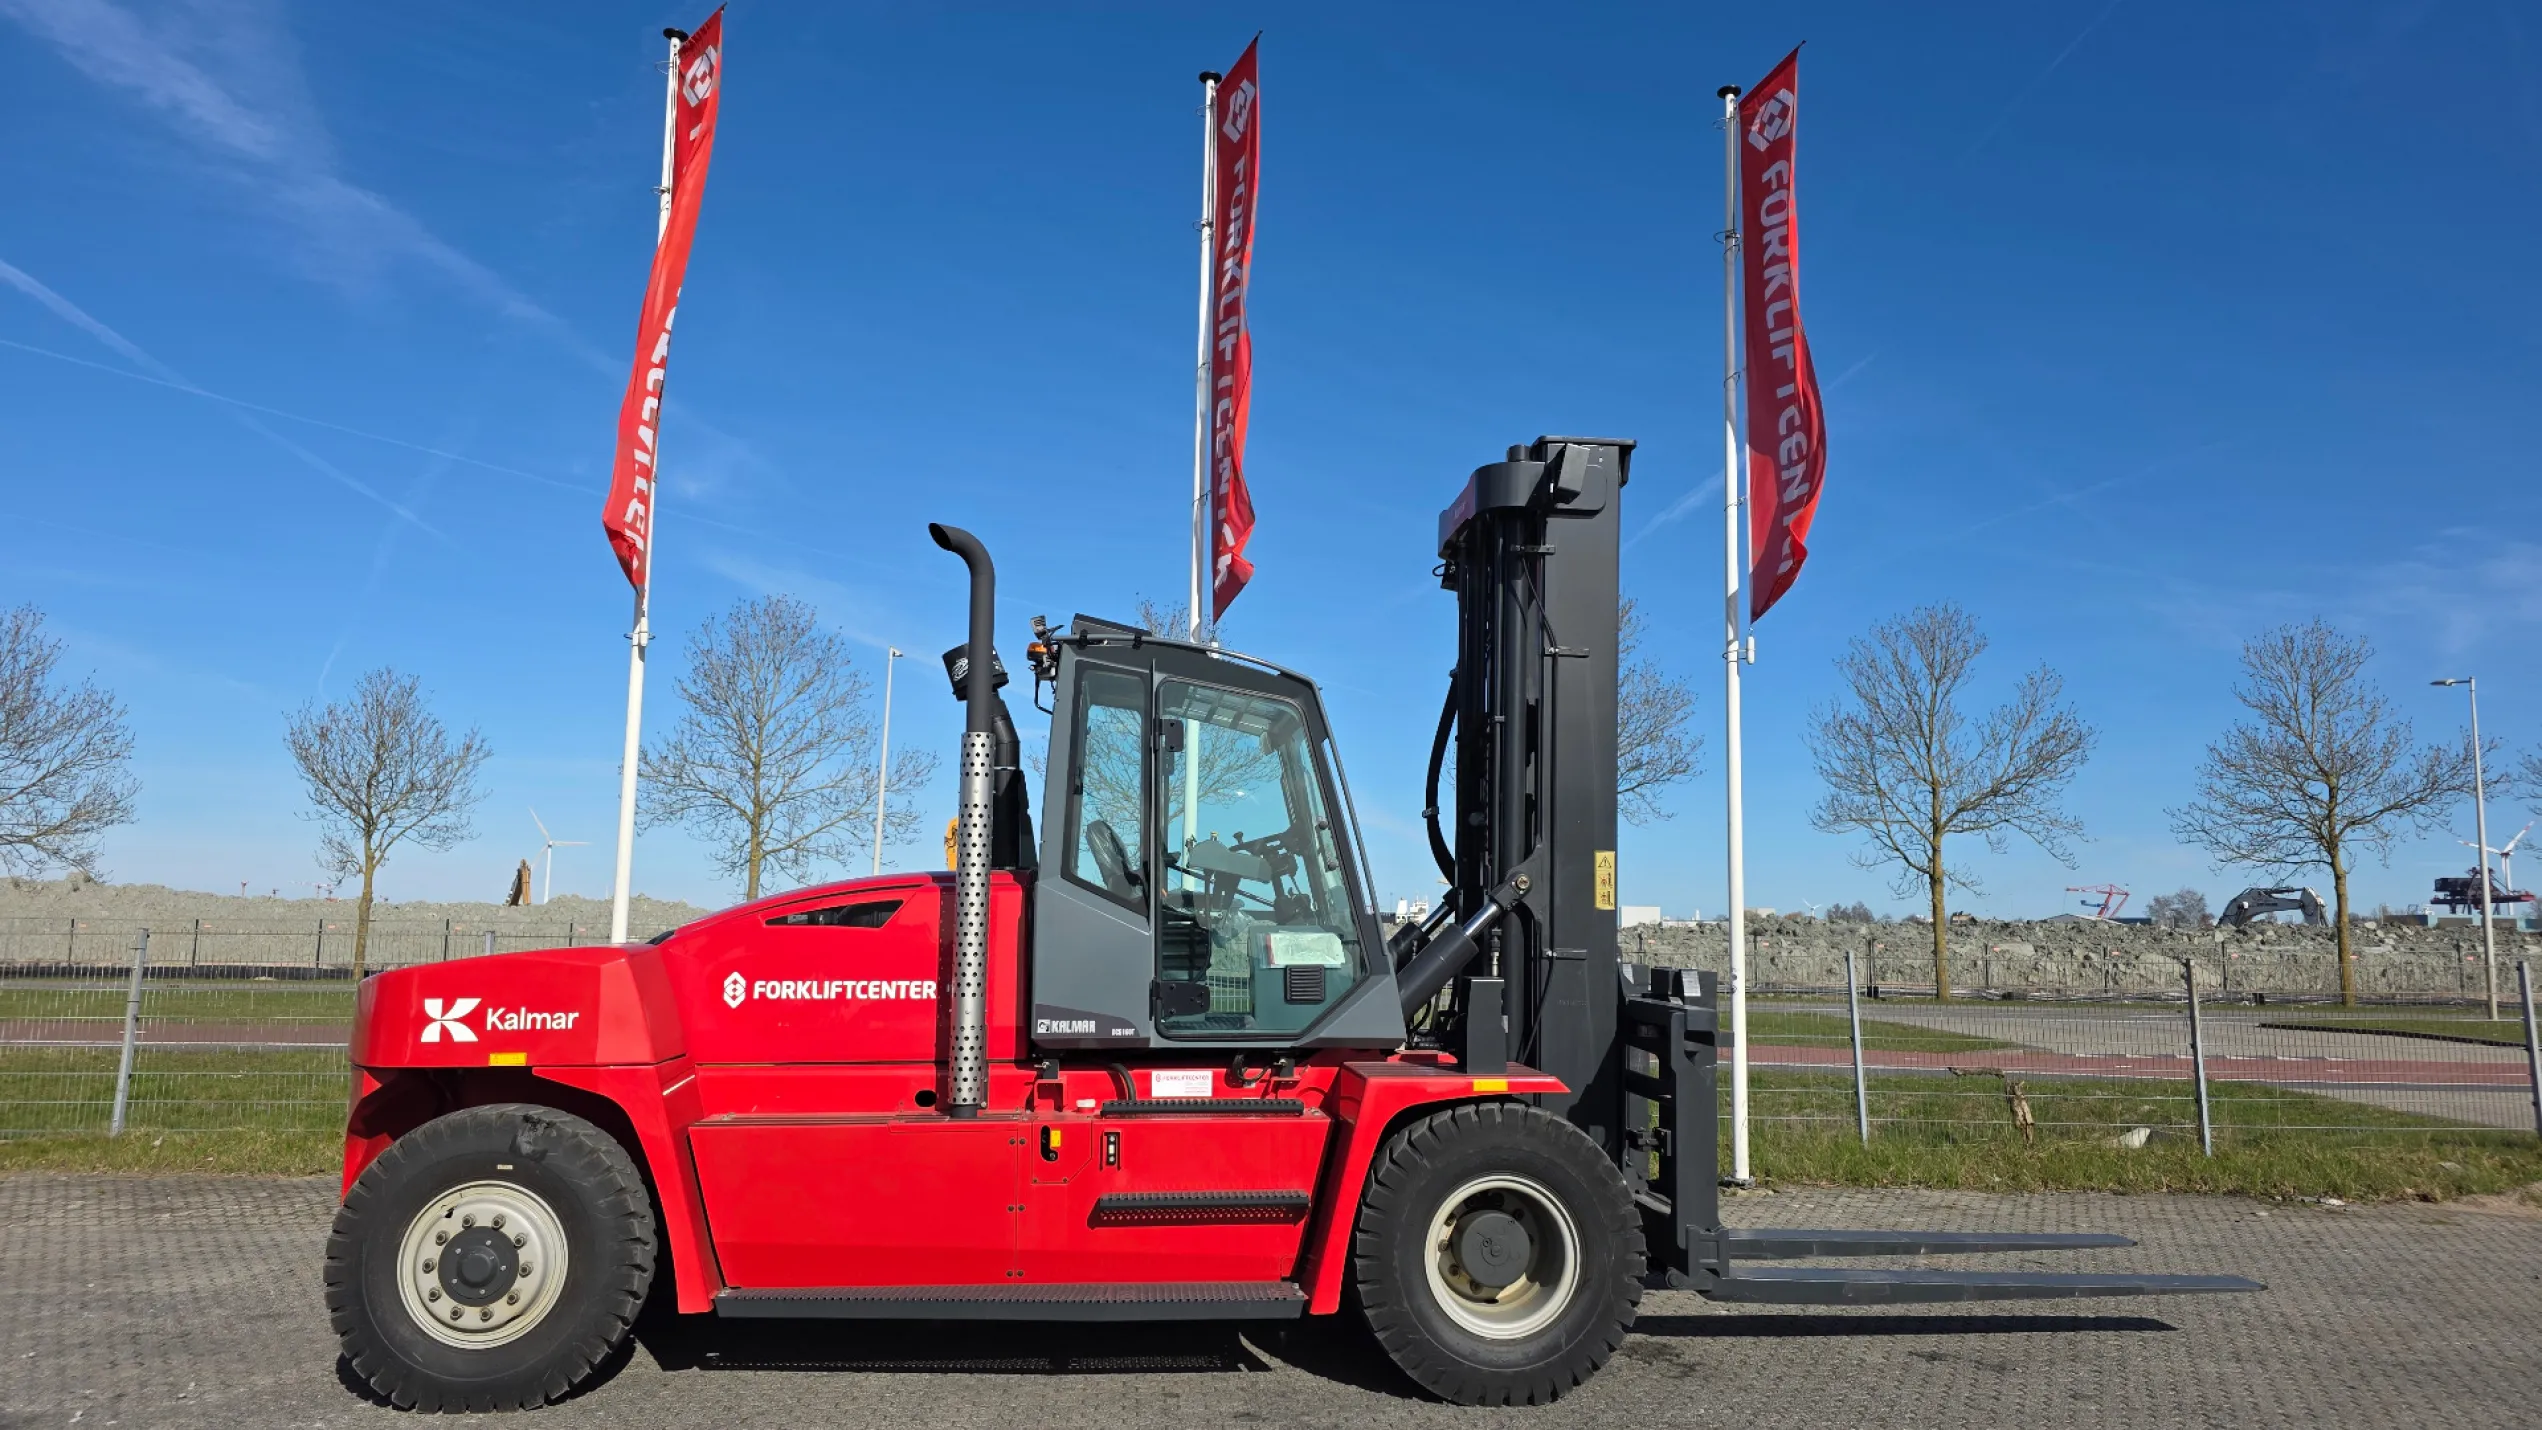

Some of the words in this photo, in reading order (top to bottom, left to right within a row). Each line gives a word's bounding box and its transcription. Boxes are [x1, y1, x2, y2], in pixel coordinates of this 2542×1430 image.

[1761, 160, 1809, 577] FORKLIFCEN
[752, 980, 937, 999] FORKLIFTCENTER
[486, 1006, 579, 1031] Kalmar
